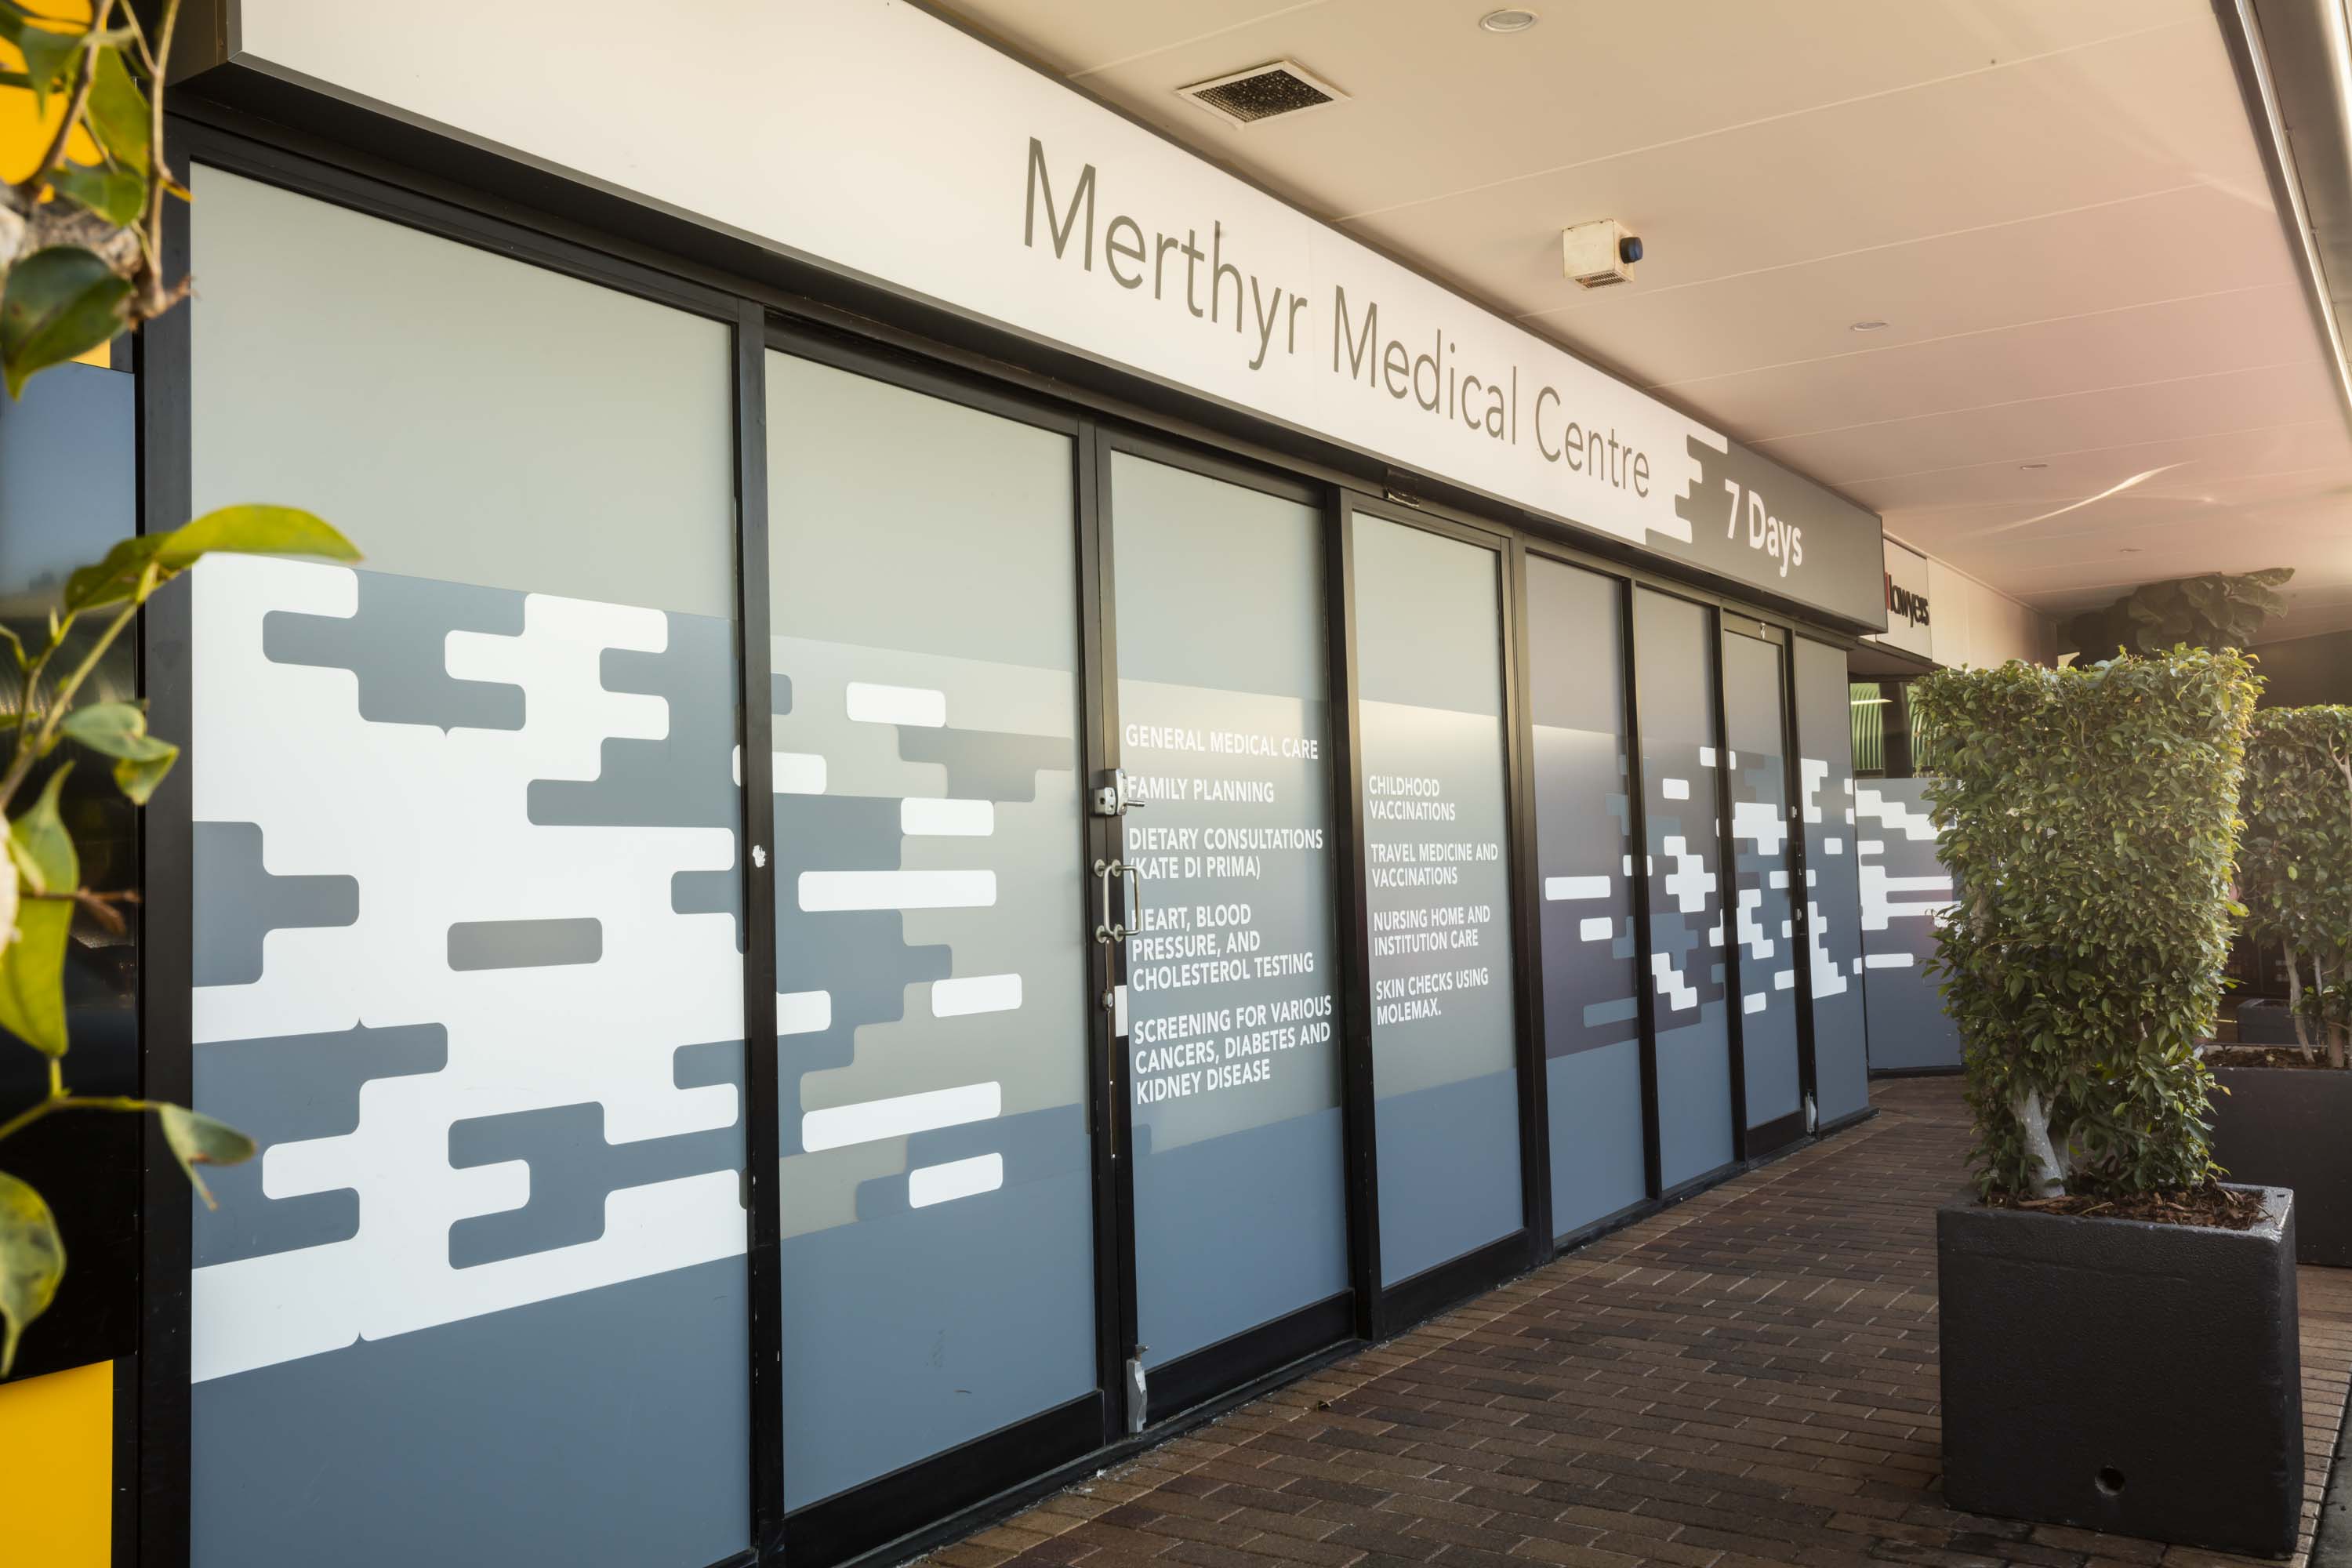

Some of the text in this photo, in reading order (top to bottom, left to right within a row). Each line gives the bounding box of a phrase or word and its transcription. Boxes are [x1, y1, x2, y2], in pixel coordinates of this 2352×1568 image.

[1024, 136, 1650, 498] Merthyr Medical Centre
[1726, 478, 1802, 577] 7 Days
[1126, 724, 1318, 759] GENERAL MEDICAL CARE
[1128, 776, 1274, 803] FAMILY PLANNING
[1369, 775, 1439, 797] CHILDHOOD
[1370, 800, 1455, 821] VACCINATIONS
[1129, 828, 1323, 851] DIETARY CONSULTATIONS
[1371, 843, 1498, 863] TRAVEL MEDICINE AND
[1131, 855, 1260, 882] (KATE DI PRIMA)
[1372, 866, 1457, 887] VACCINATIONS
[1131, 904, 1250, 931] HEART, BLOOD
[1374, 906, 1490, 931] NURSING HOME AND
[1132, 931, 1260, 961] PRESSURE, AND
[1374, 928, 1479, 956] INSTITUTION CARE
[1133, 952, 1313, 991] CHOLESTEROL TESTING
[1377, 967, 1488, 1000] SKIN CHECKS USING
[1134, 995, 1331, 1044] SCREENING FOR VARIOUS
[1377, 997, 1442, 1025] MOLEMAX.
[1136, 1022, 1330, 1074] CANCERS, DIABETES AND
[1137, 1058, 1270, 1105] KIDNEY DISEASE
